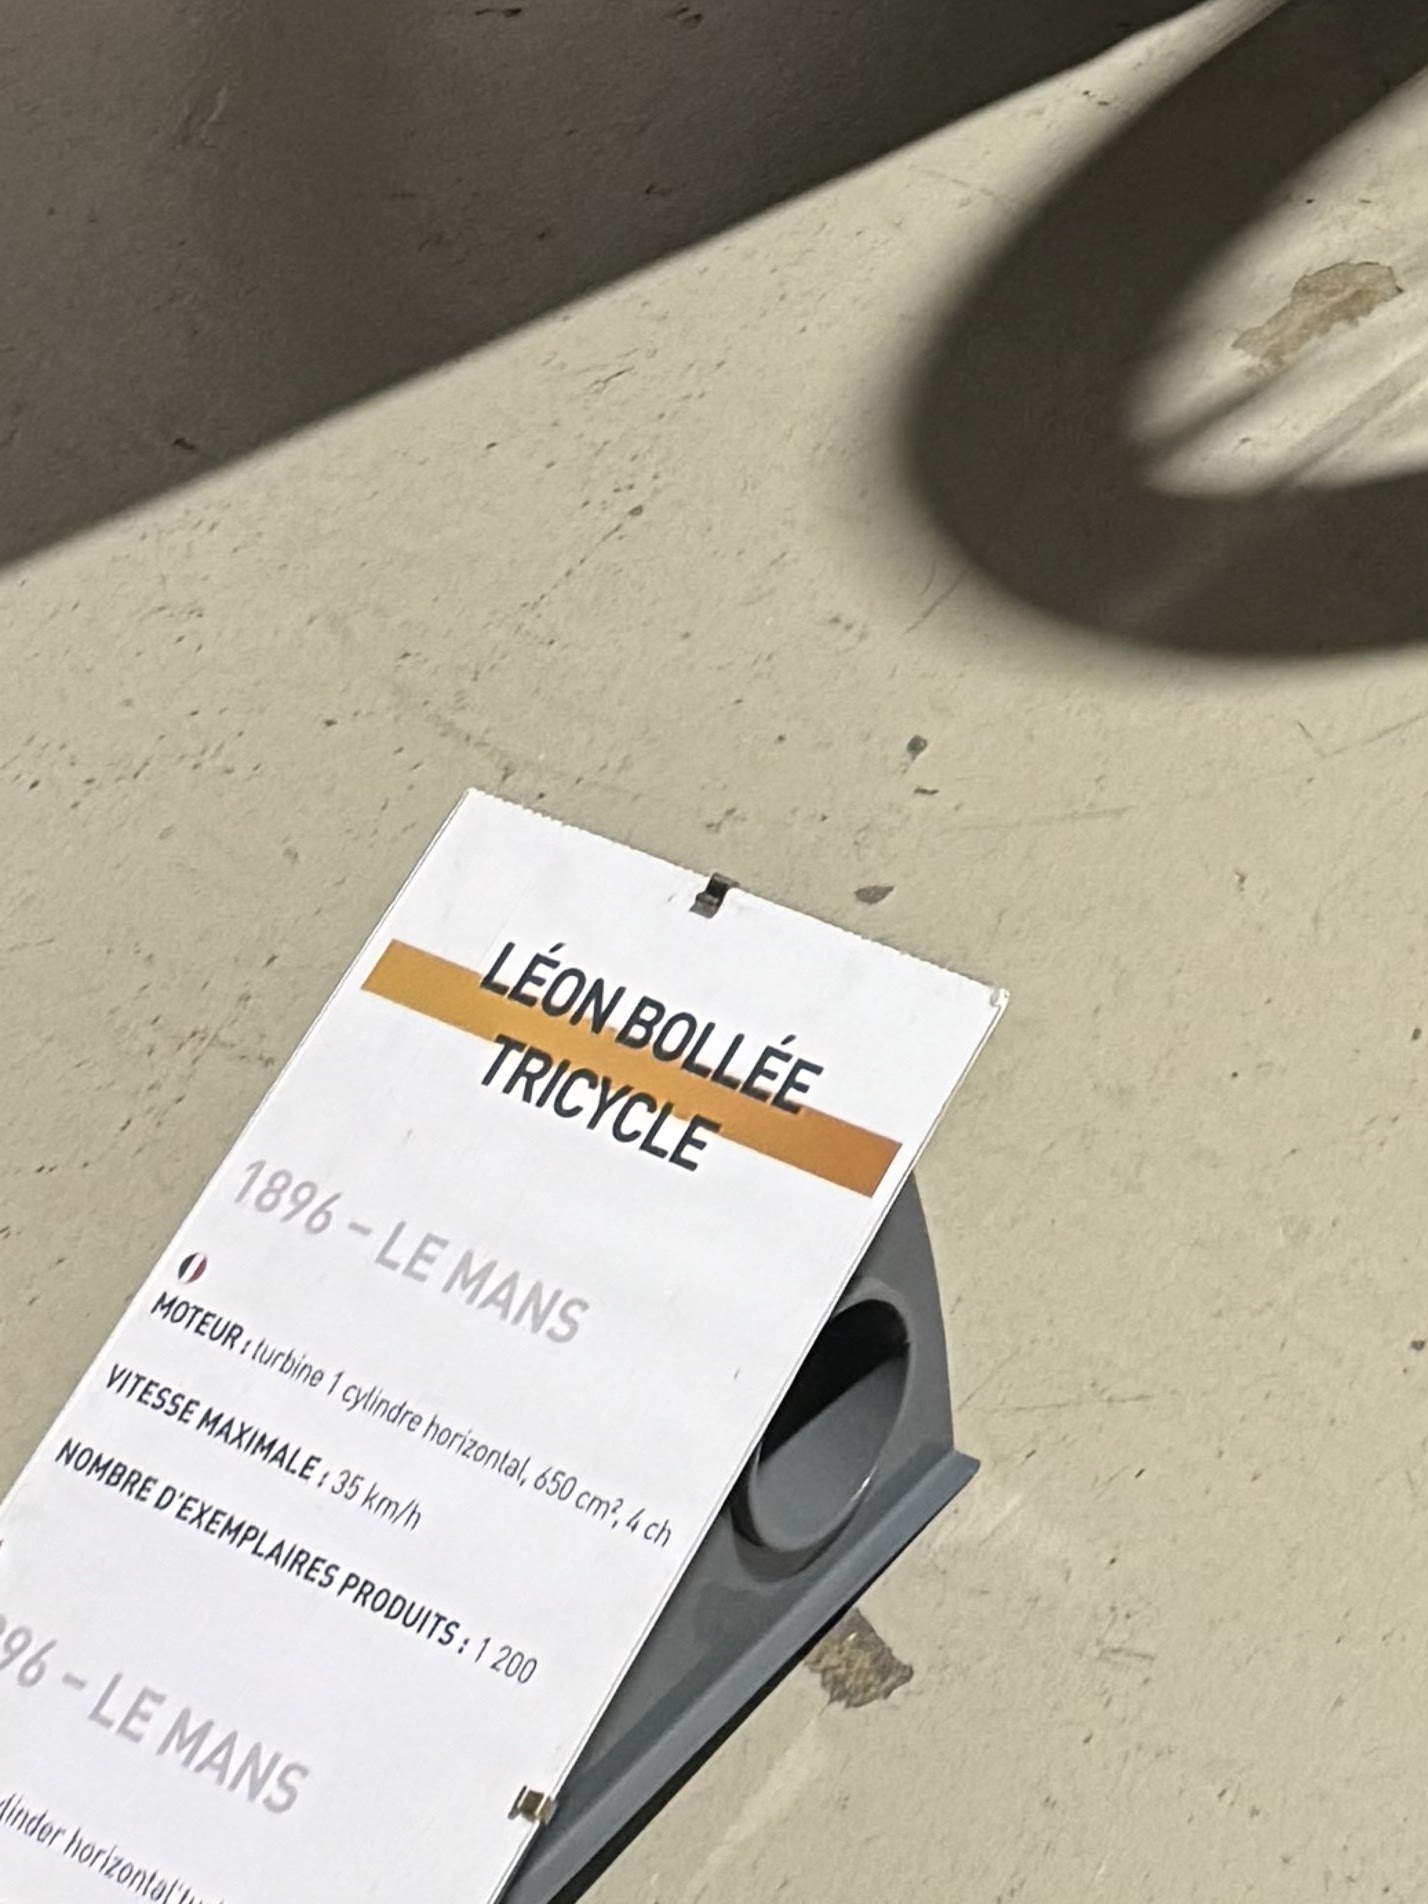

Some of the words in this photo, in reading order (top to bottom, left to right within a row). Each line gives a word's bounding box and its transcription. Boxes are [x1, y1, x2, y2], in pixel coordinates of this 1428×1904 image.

[480, 941, 626, 1035] LÉON
[615, 994, 824, 1115] BOLLÉE
[481, 1033, 722, 1172] TRICYCLE
[234, 1159, 341, 1235] 1896
[374, 1220, 449, 1283] LE
[441, 1249, 590, 1344] MANS
[105, 1363, 201, 1425] VITESSE
[196, 1407, 322, 1481] MAXIMALE
[330, 1469, 365, 1501] 35
[360, 1482, 423, 1531] km/h
[150, 1291, 244, 1351] MOTEUR
[251, 1338, 324, 1388] turbine
[326, 1370, 345, 1396] 1
[342, 1385, 423, 1432] cylindre
[422, 1413, 532, 1487] horizontal,
[533, 1466, 578, 1502] 650
[626, 1507, 647, 1534] 4
[643, 1519, 673, 1548] ch
[54, 1438, 158, 1503] NOMBRE
[335, 1571, 461, 1646] PRODUITS
[490, 1645, 538, 1685] 200
[0, 1612, 58, 1688] 96
[88, 1671, 168, 1744] LE
[155, 1705, 310, 1814] MANS
[0, 1792, 66, 1848] linder
